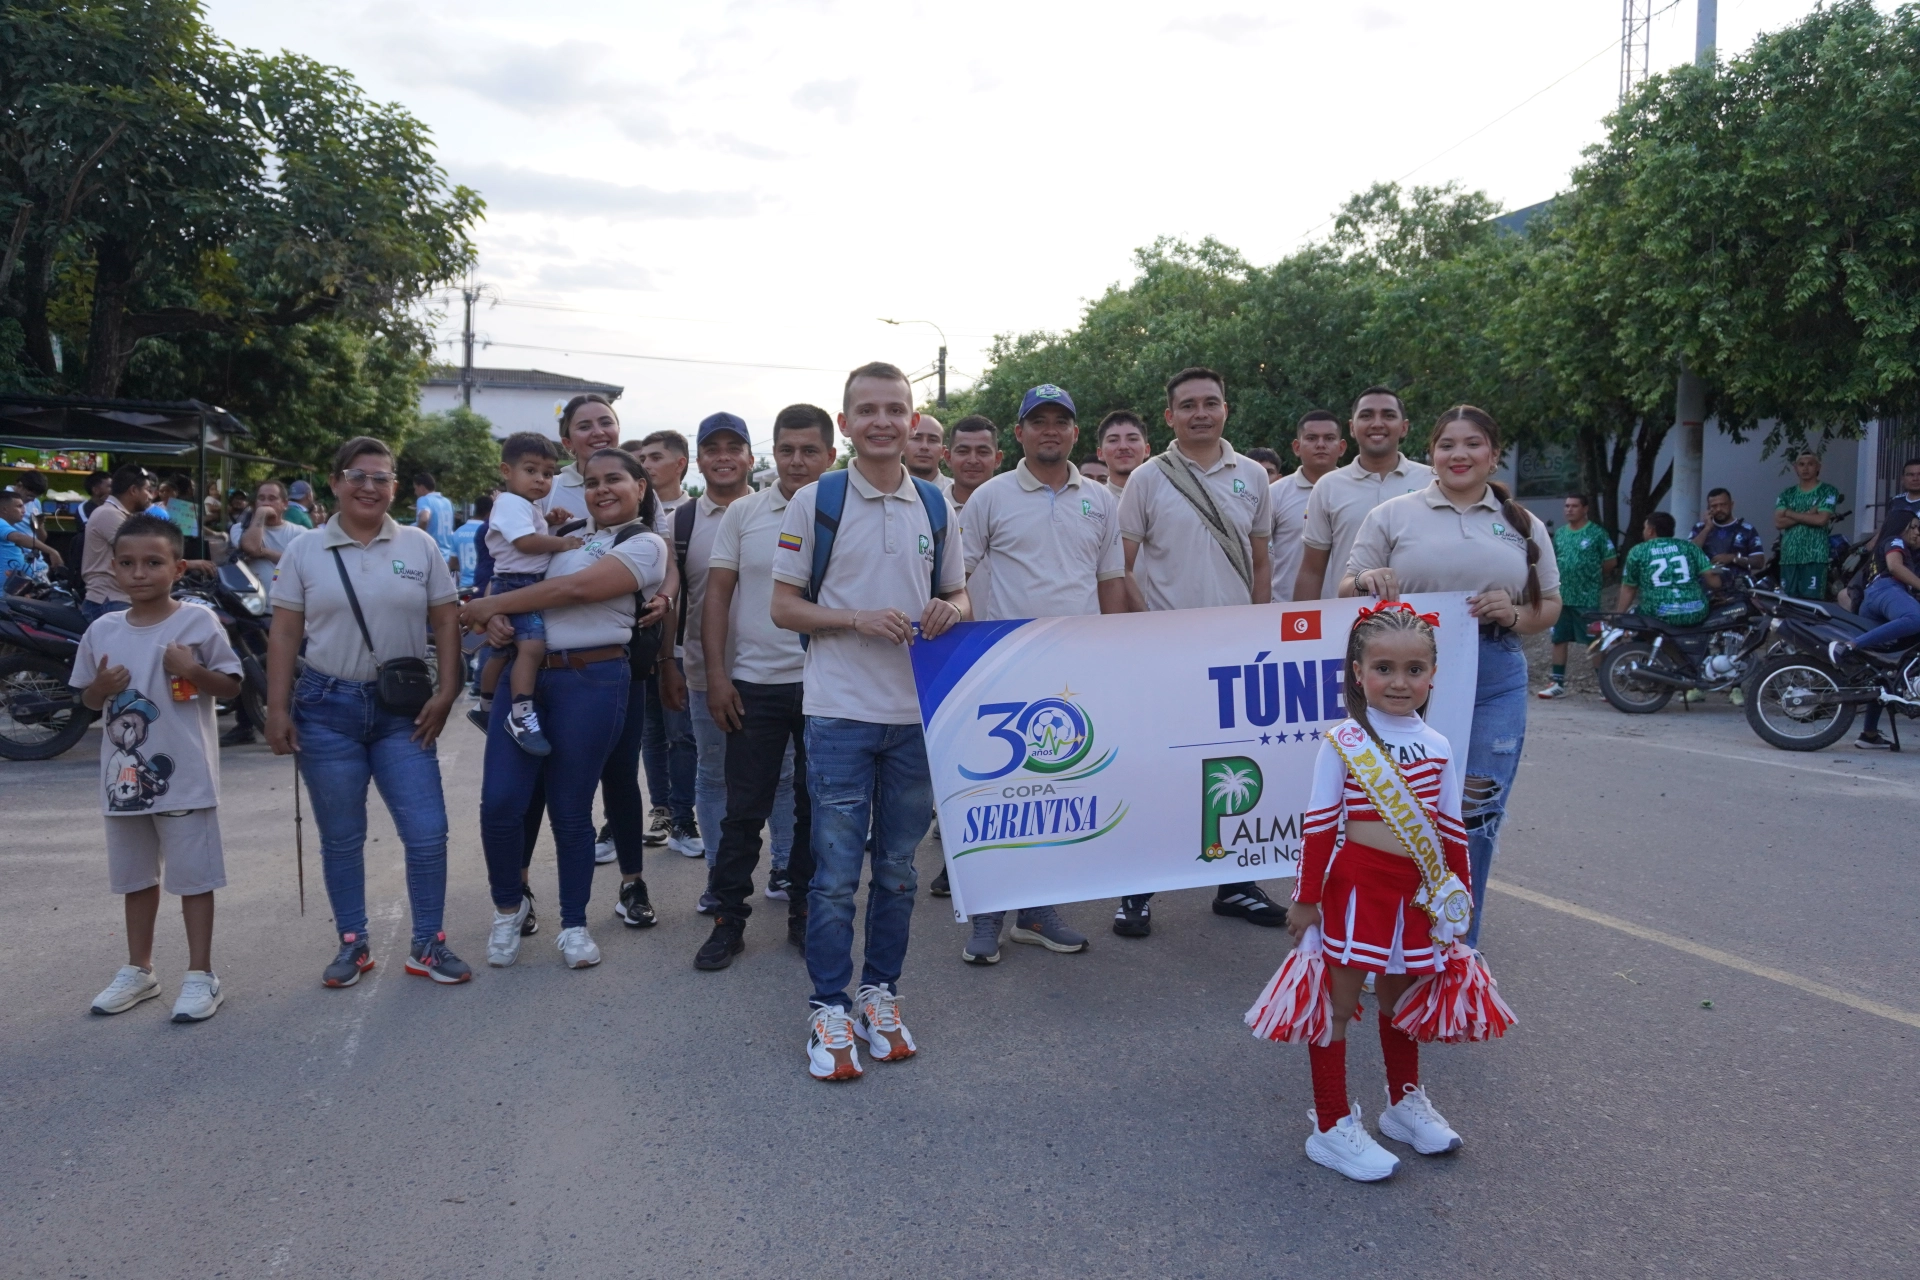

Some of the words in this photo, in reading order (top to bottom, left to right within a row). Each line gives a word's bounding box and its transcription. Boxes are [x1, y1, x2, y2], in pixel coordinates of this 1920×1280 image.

[1649, 555, 1691, 587] 23
[1809, 576, 1816, 587] 3
[1208, 650, 1349, 730] TÚNE
[957, 697, 1087, 781] 30
[1031, 749, 1053, 757] años
[1381, 738, 1428, 763] TALY
[1002, 783, 1057, 799] COPA
[1201, 756, 1305, 856] PALMI
[962, 795, 1098, 844] SERINTSA
[1352, 748, 1442, 882] PALMIAGRO
[1237, 846, 1266, 868] del
